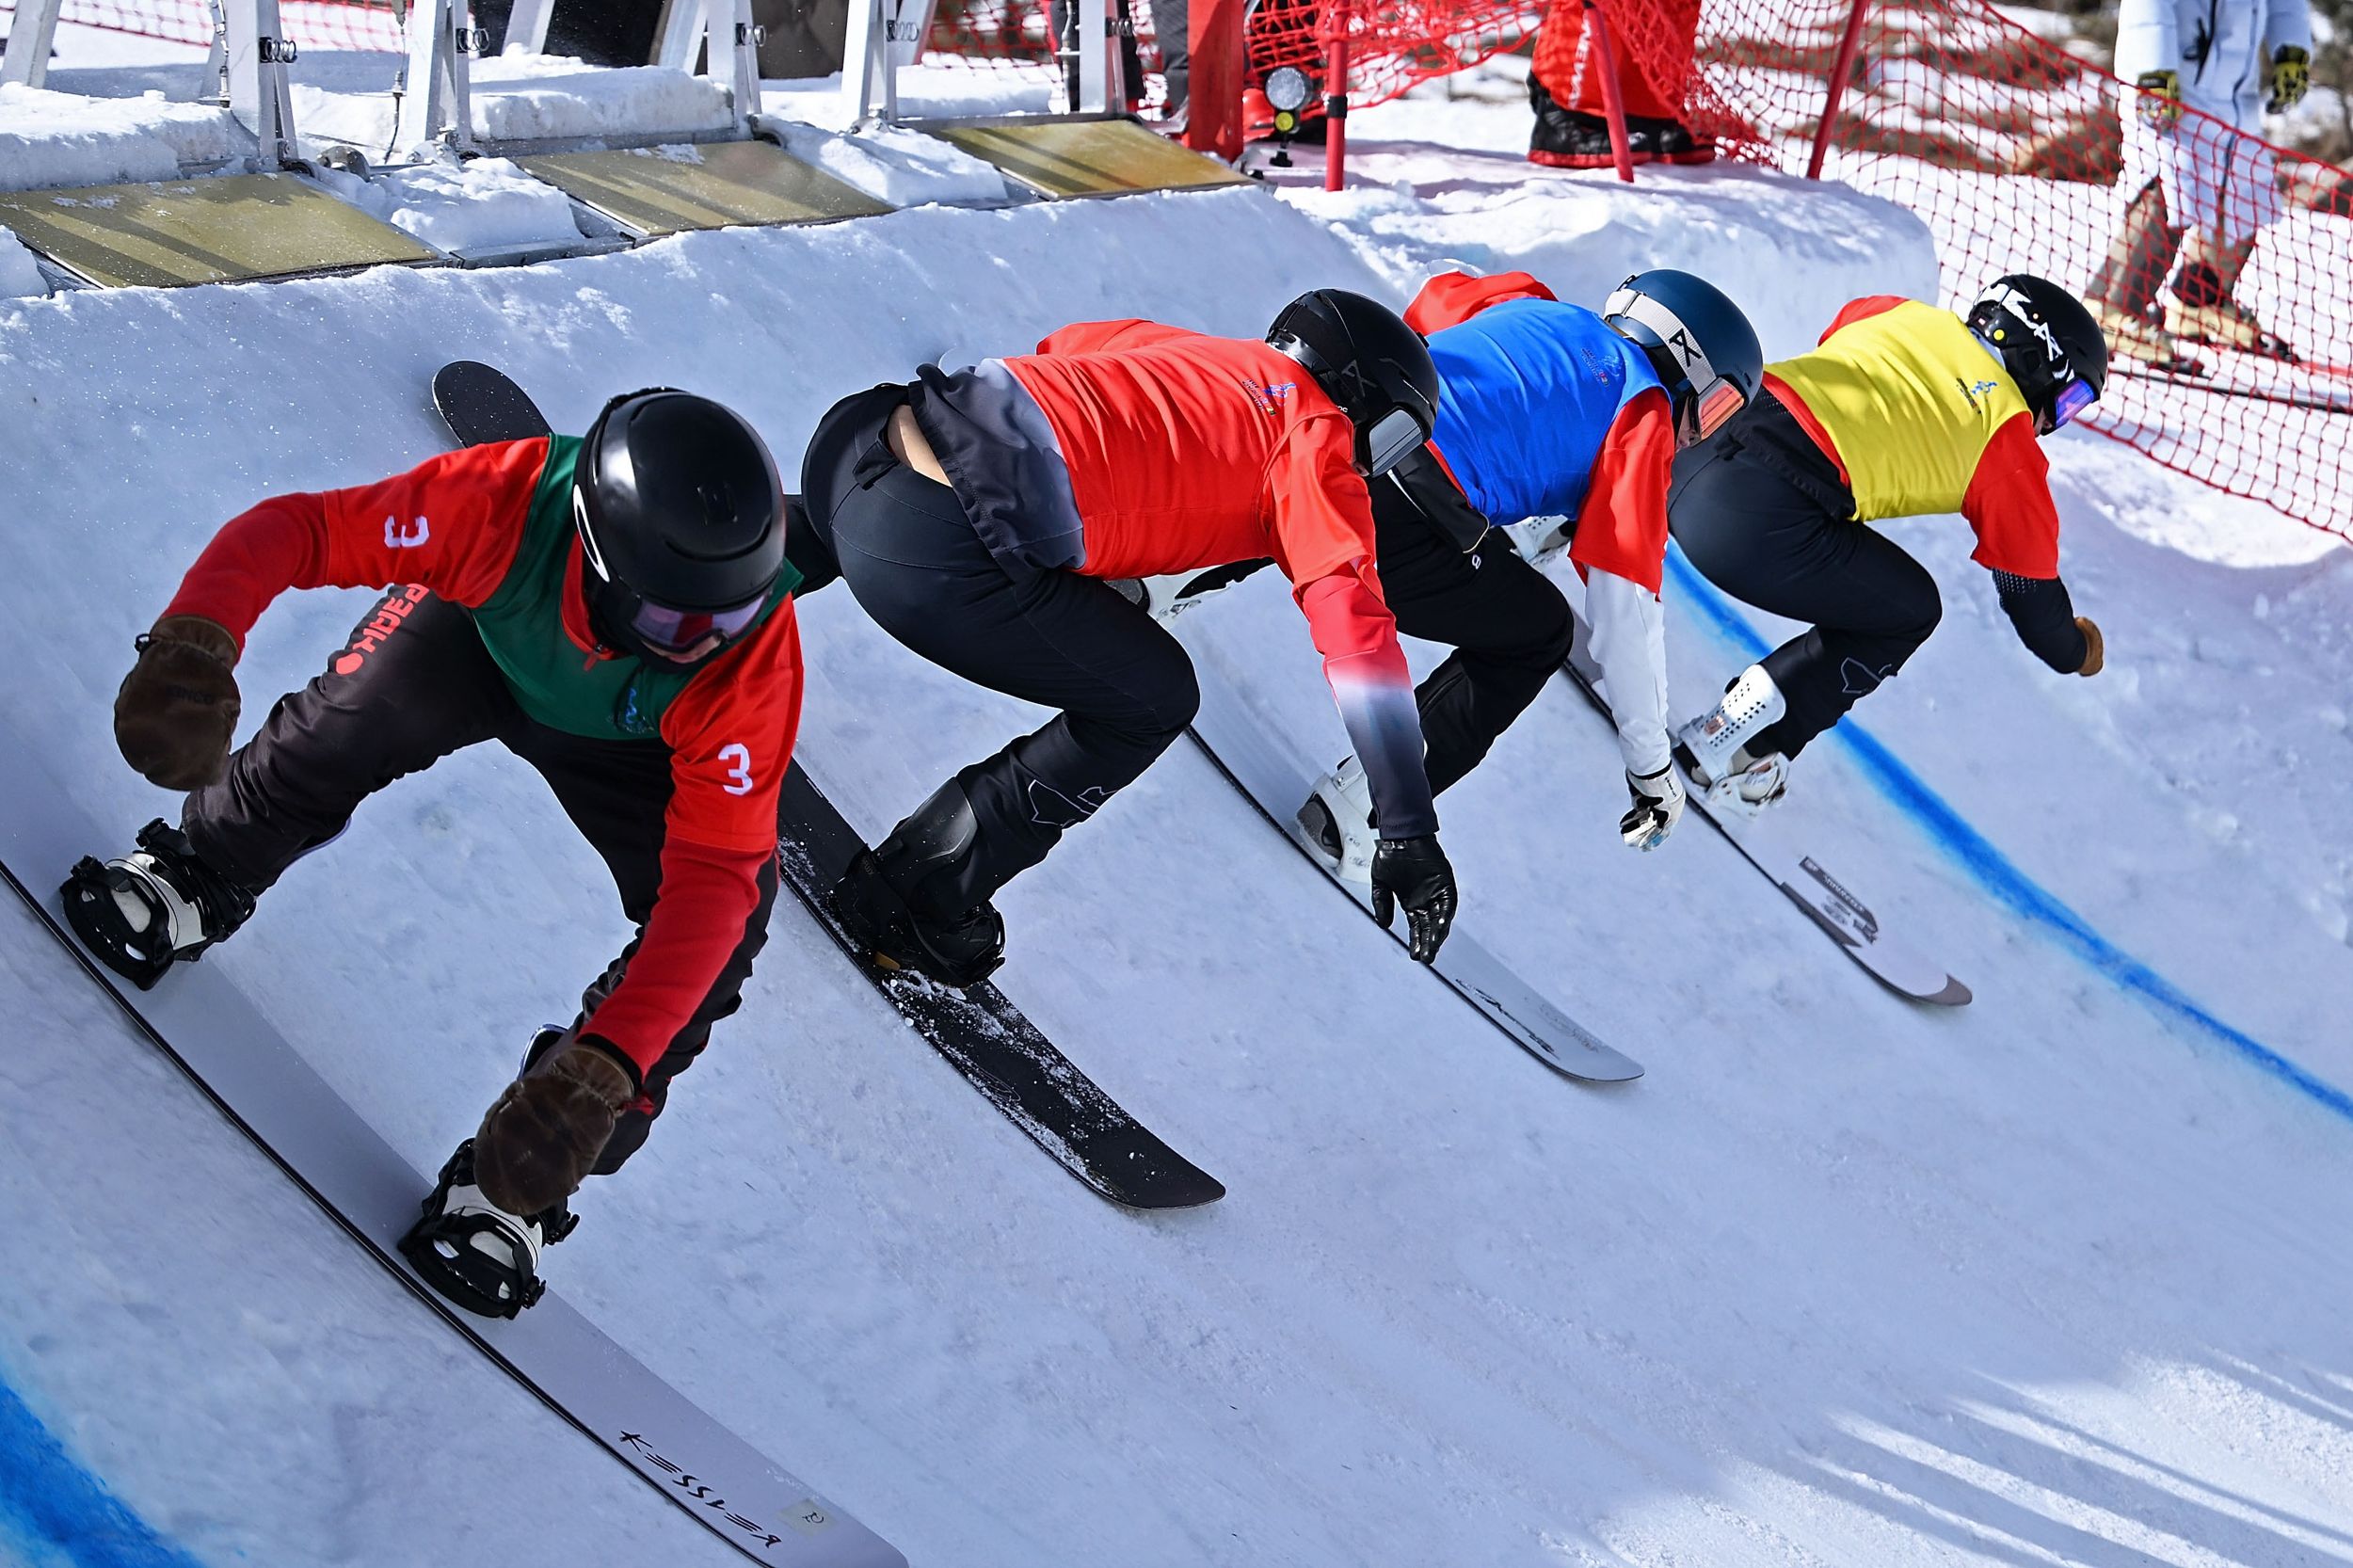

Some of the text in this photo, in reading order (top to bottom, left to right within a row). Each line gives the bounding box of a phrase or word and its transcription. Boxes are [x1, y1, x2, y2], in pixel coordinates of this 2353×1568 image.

[384, 515, 430, 549] 3
[718, 743, 754, 796] 3
[619, 1430, 782, 1549] KESSLER
